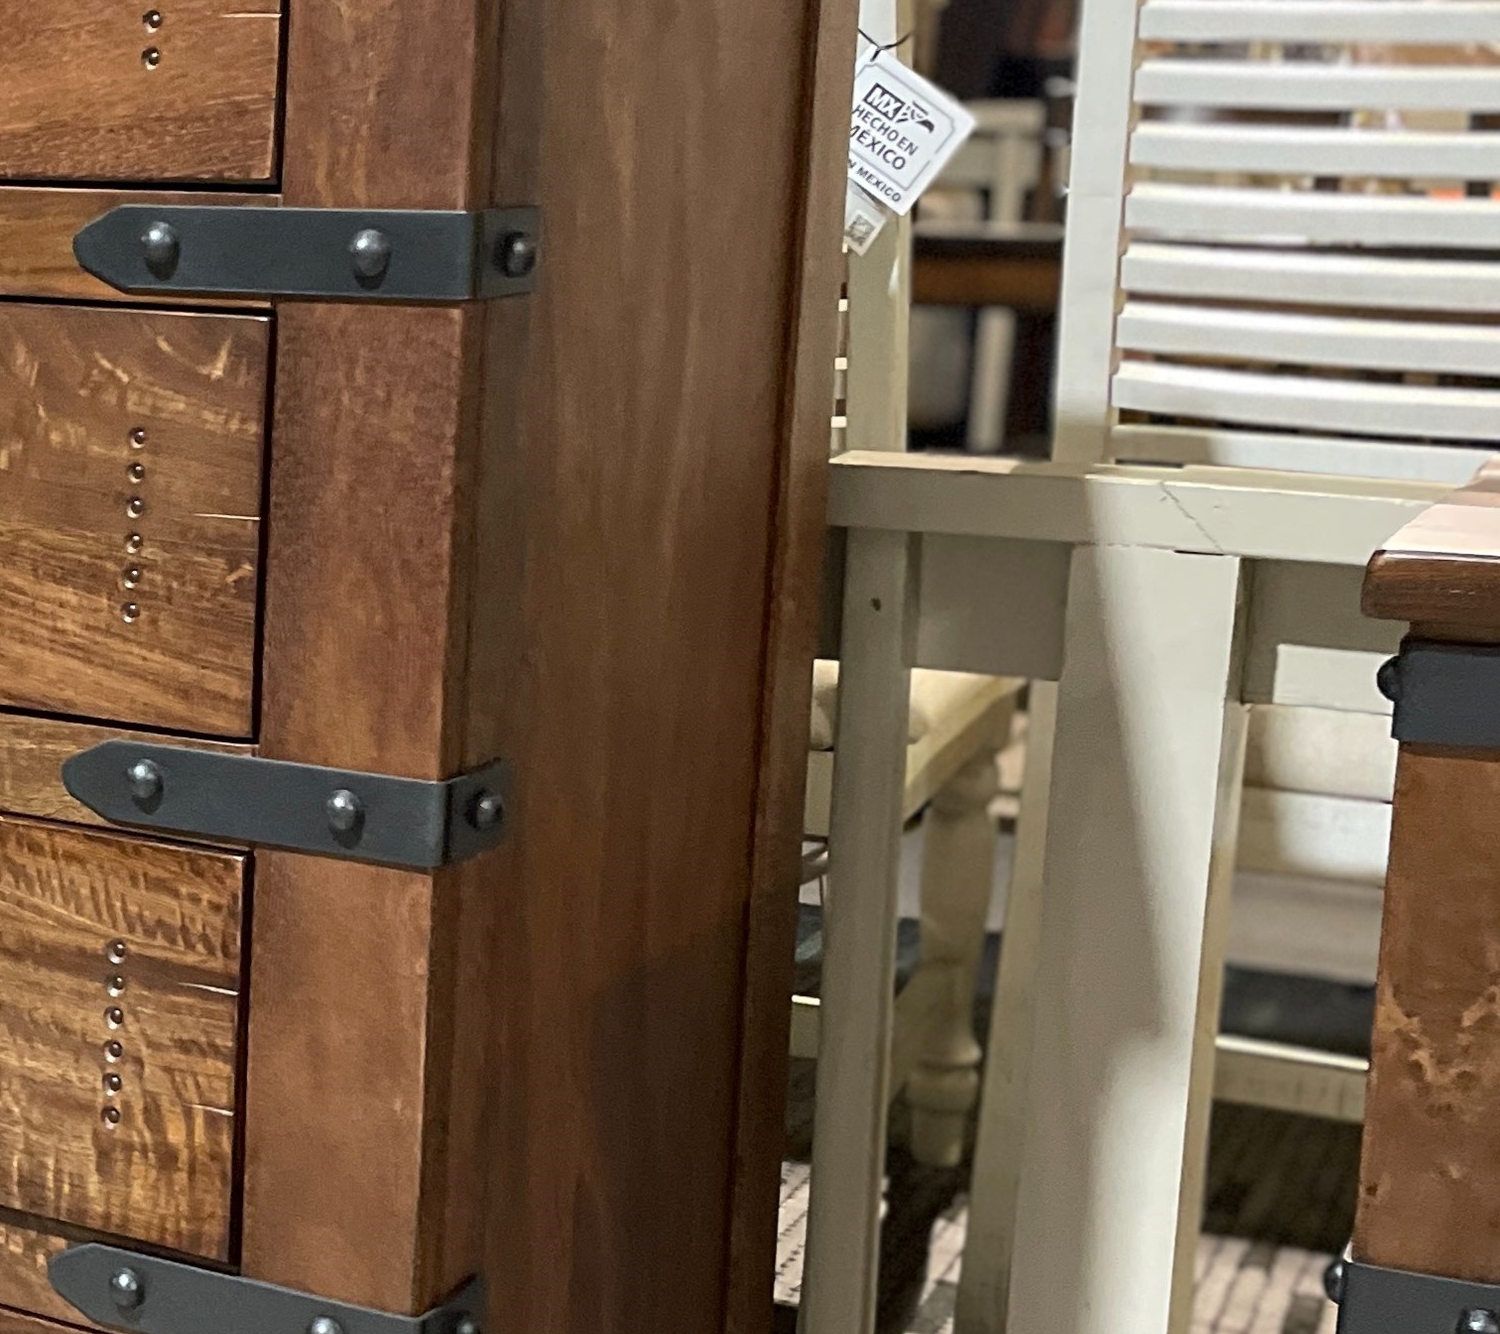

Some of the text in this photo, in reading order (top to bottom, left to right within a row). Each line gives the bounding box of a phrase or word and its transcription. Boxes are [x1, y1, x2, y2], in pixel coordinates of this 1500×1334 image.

[853, 105, 918, 156] HECHO EN
[858, 167, 901, 202] MEXICO
